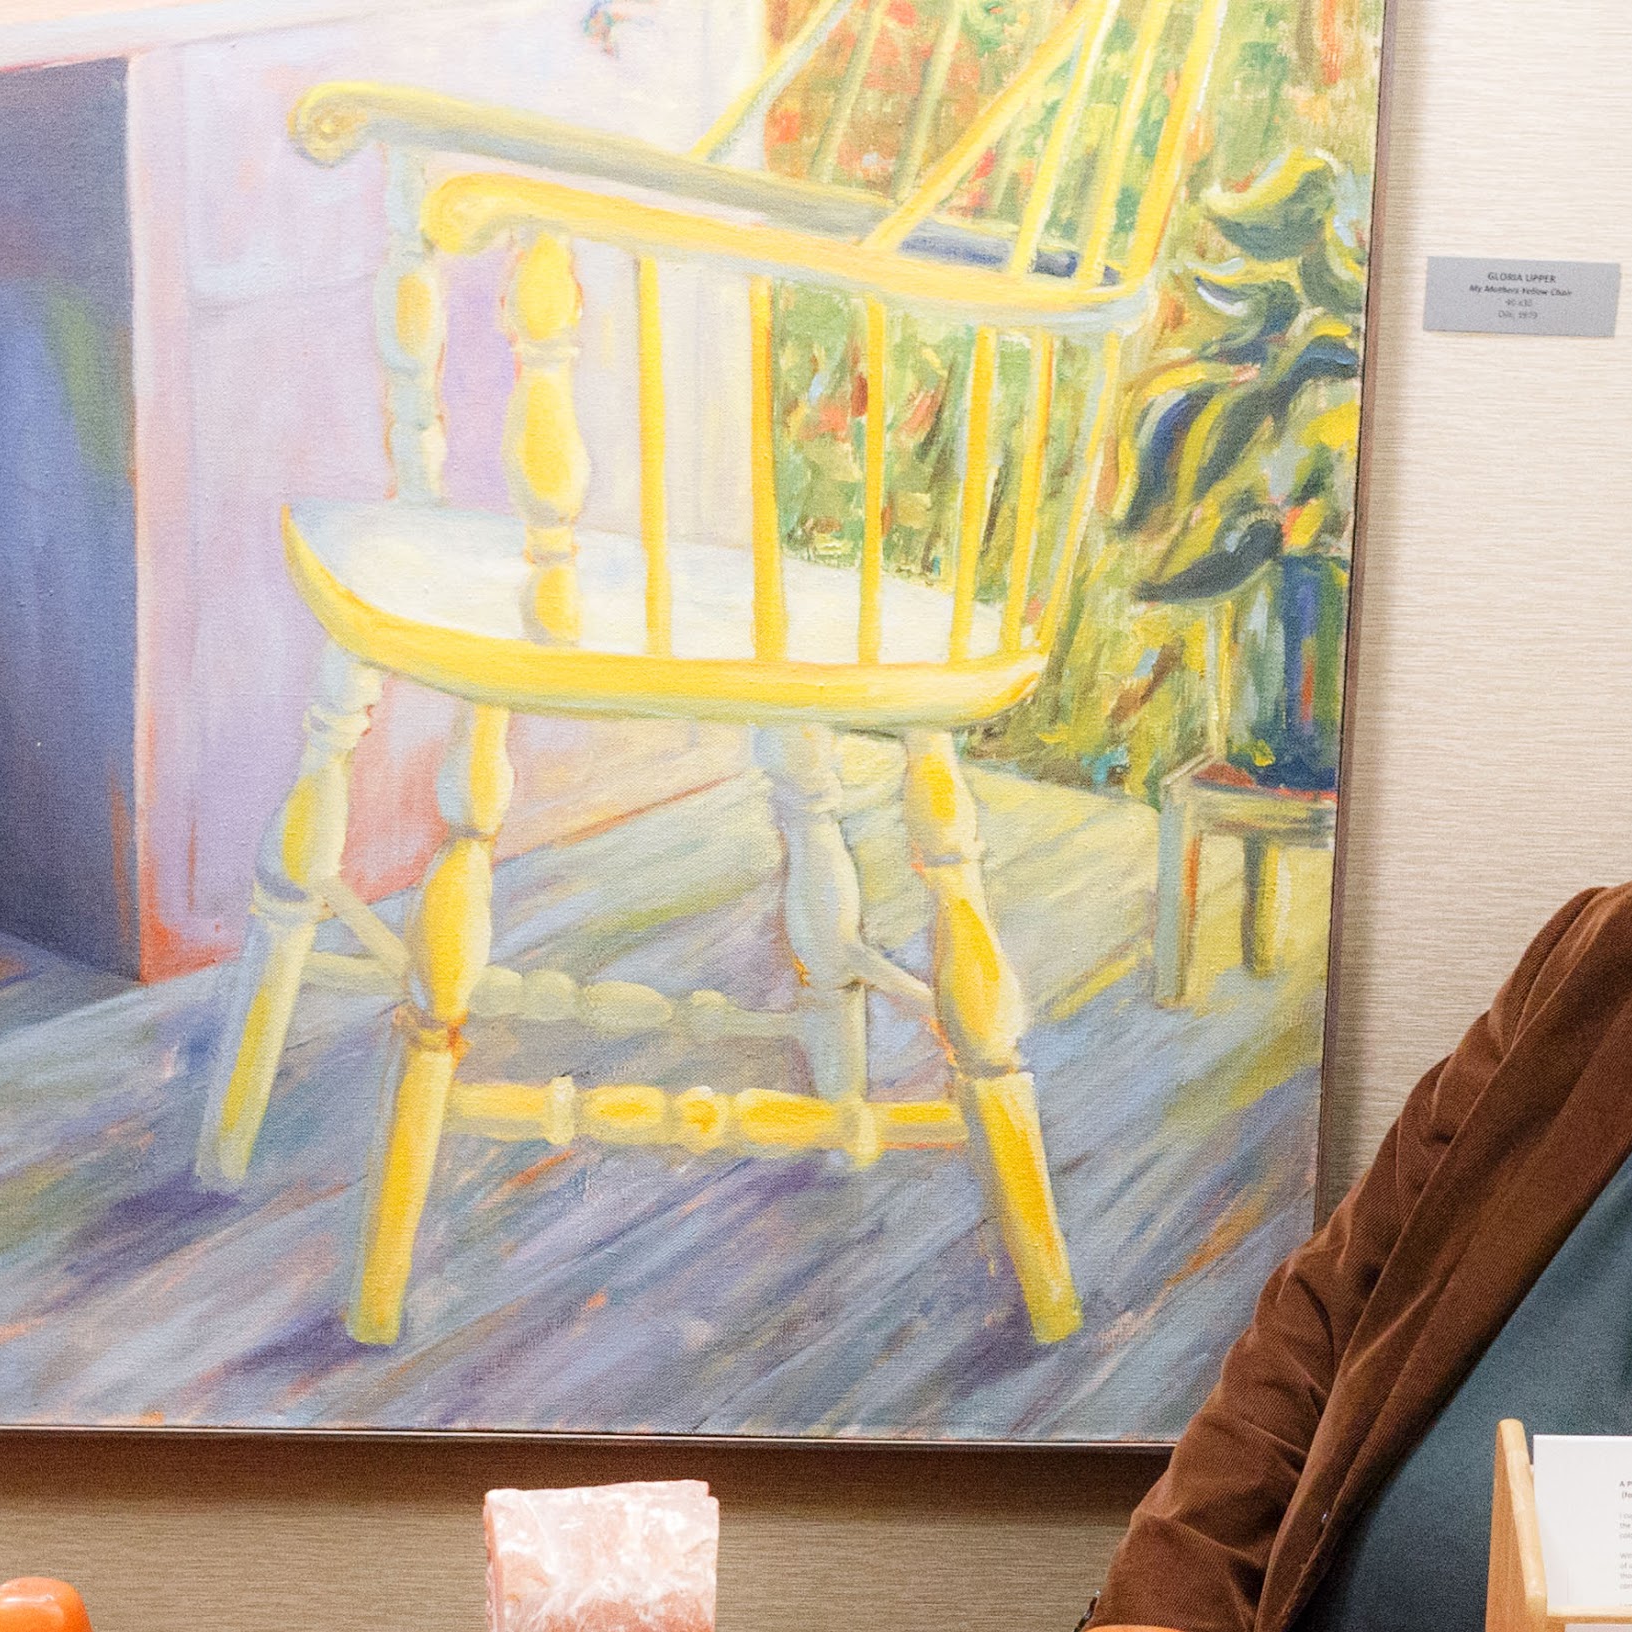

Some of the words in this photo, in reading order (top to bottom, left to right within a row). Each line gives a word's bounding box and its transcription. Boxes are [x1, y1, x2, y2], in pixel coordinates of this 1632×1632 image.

[1487, 272, 1523, 281] GLORIA
[1526, 274, 1556, 283] LIPPER
[1469, 284, 1482, 295] My
[1550, 288, 1573, 296] Chair
